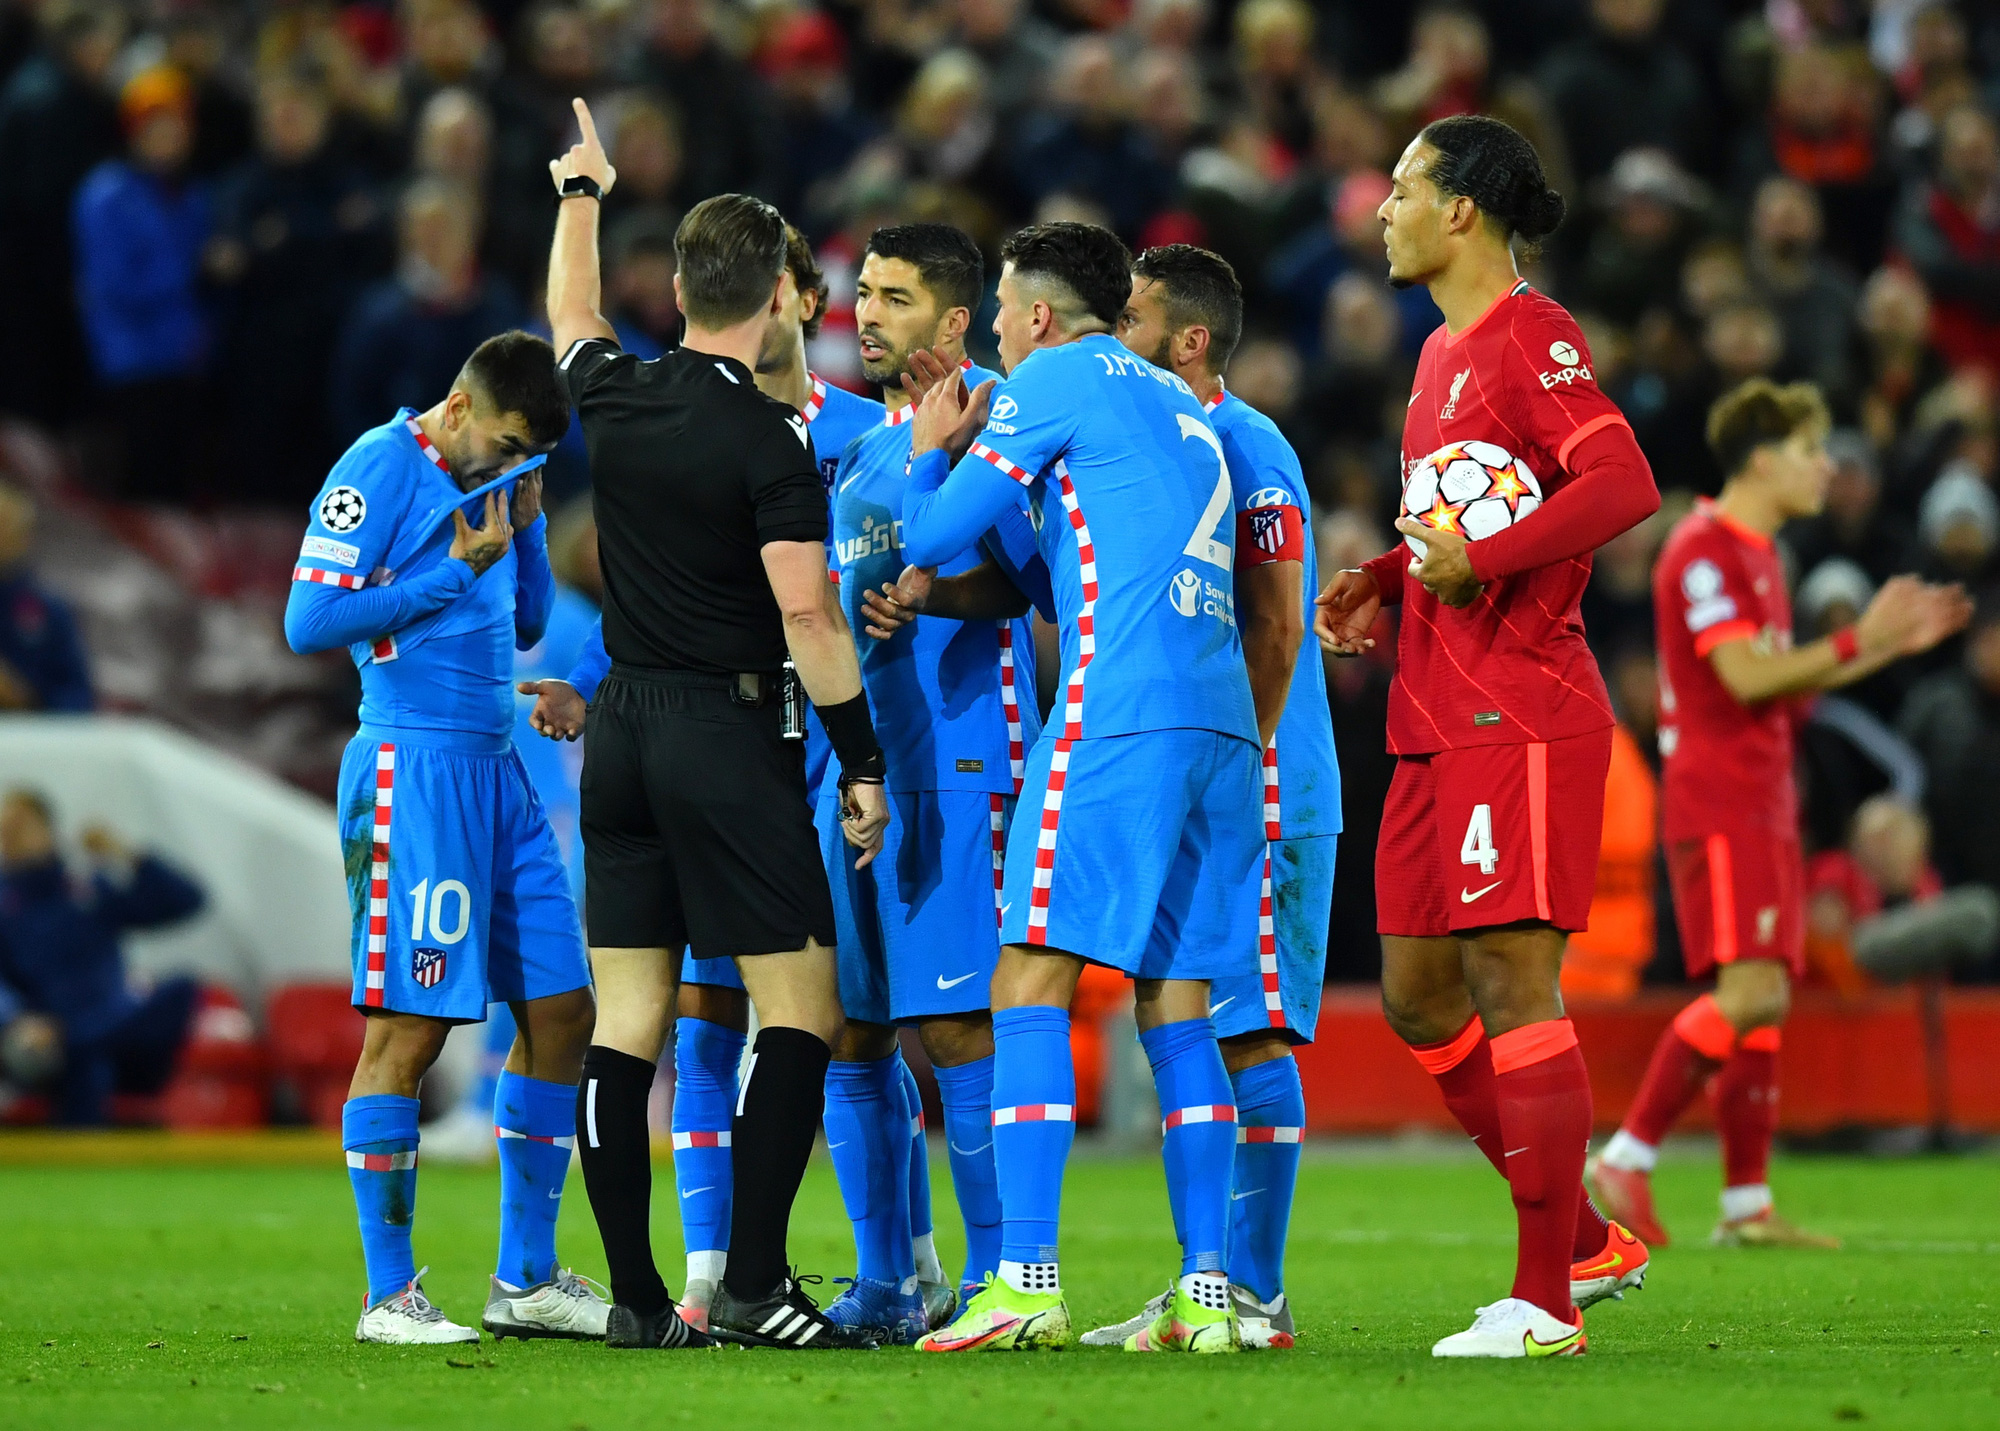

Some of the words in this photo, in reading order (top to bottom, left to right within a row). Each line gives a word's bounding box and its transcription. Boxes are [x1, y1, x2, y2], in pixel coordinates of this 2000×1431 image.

[1175, 413, 1231, 572] 2
[1205, 581, 1225, 602] Save
[1460, 804, 1499, 875] 4
[409, 877, 471, 945] 10
